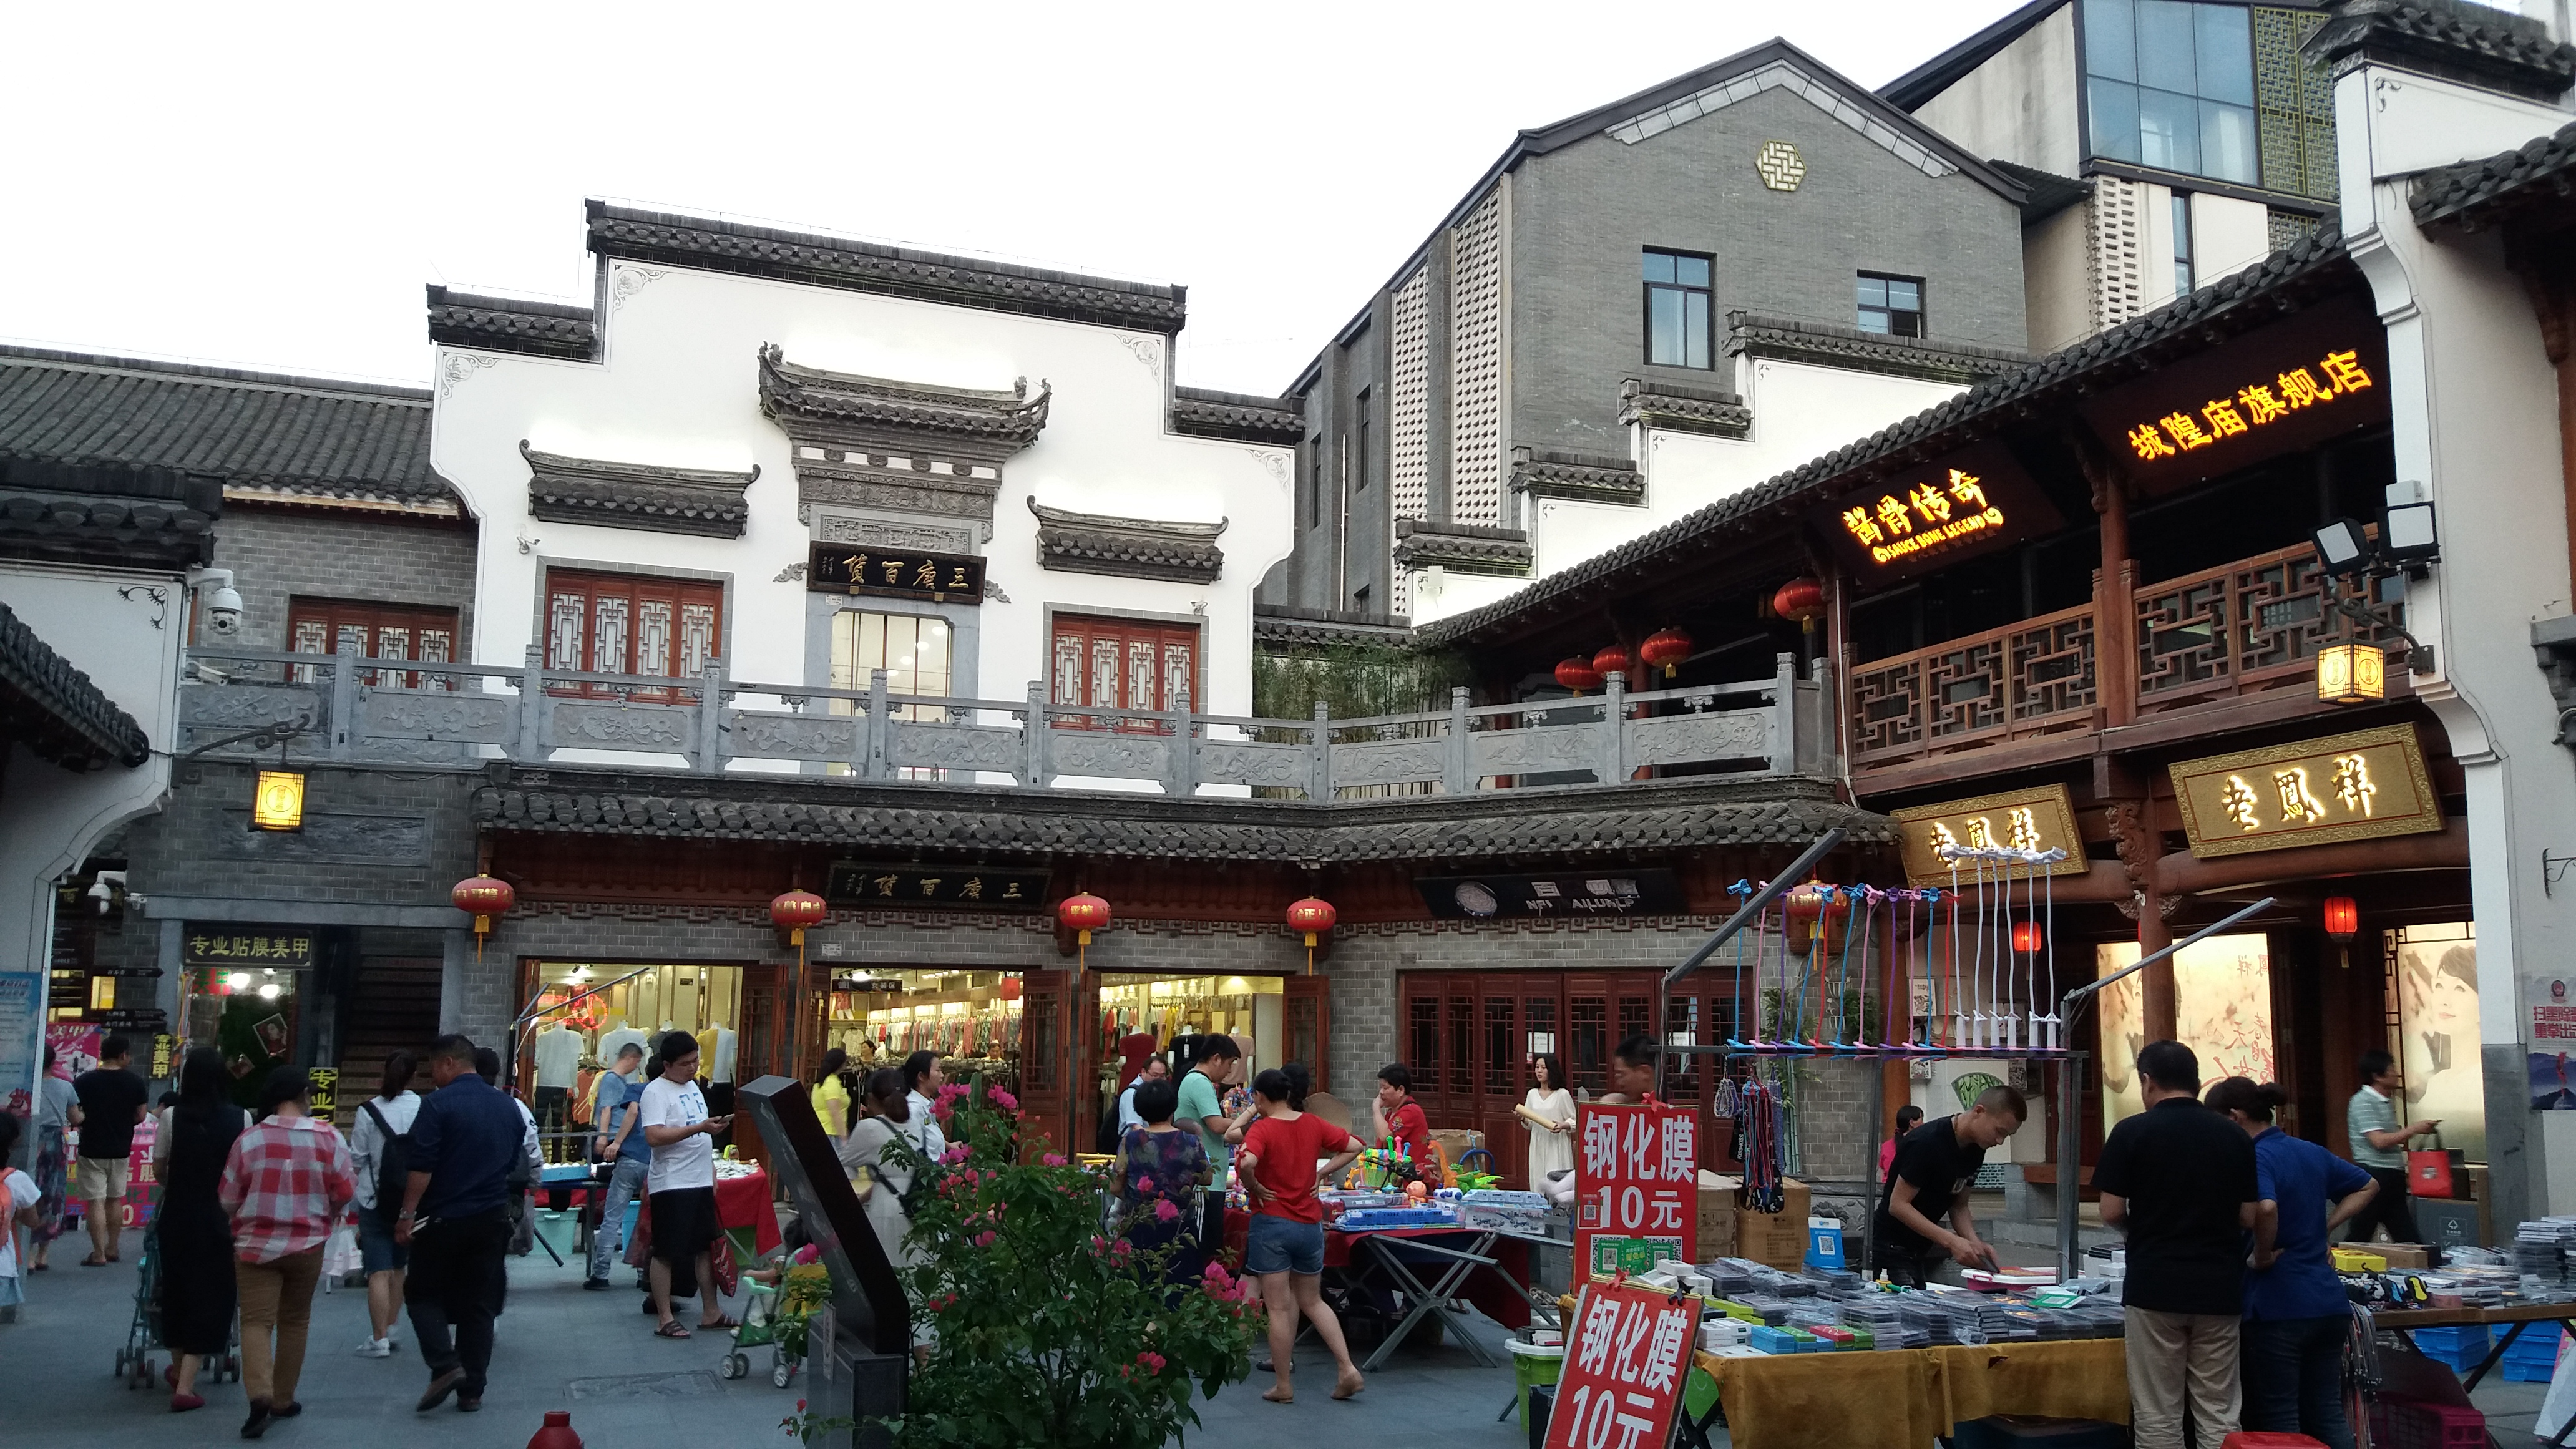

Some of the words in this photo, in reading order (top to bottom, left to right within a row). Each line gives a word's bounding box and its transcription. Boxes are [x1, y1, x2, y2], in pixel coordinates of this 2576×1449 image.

[2127, 349, 2372, 460] 城隍庙旗舰店
[1843, 468, 1988, 546] 酱骨传奇
[1886, 537, 1920, 560] SAUCE
[1915, 528, 1946, 548] BONE
[1942, 514, 1986, 538] LEGEND
[190, 934, 310, 959] 专业贴膜美甲
[1583, 1111, 1695, 1184] 钢化膜
[1597, 1186, 1683, 1229] 10元
[1578, 1293, 1688, 1395] 钢化膜
[1567, 1384, 1655, 1449] 10元
